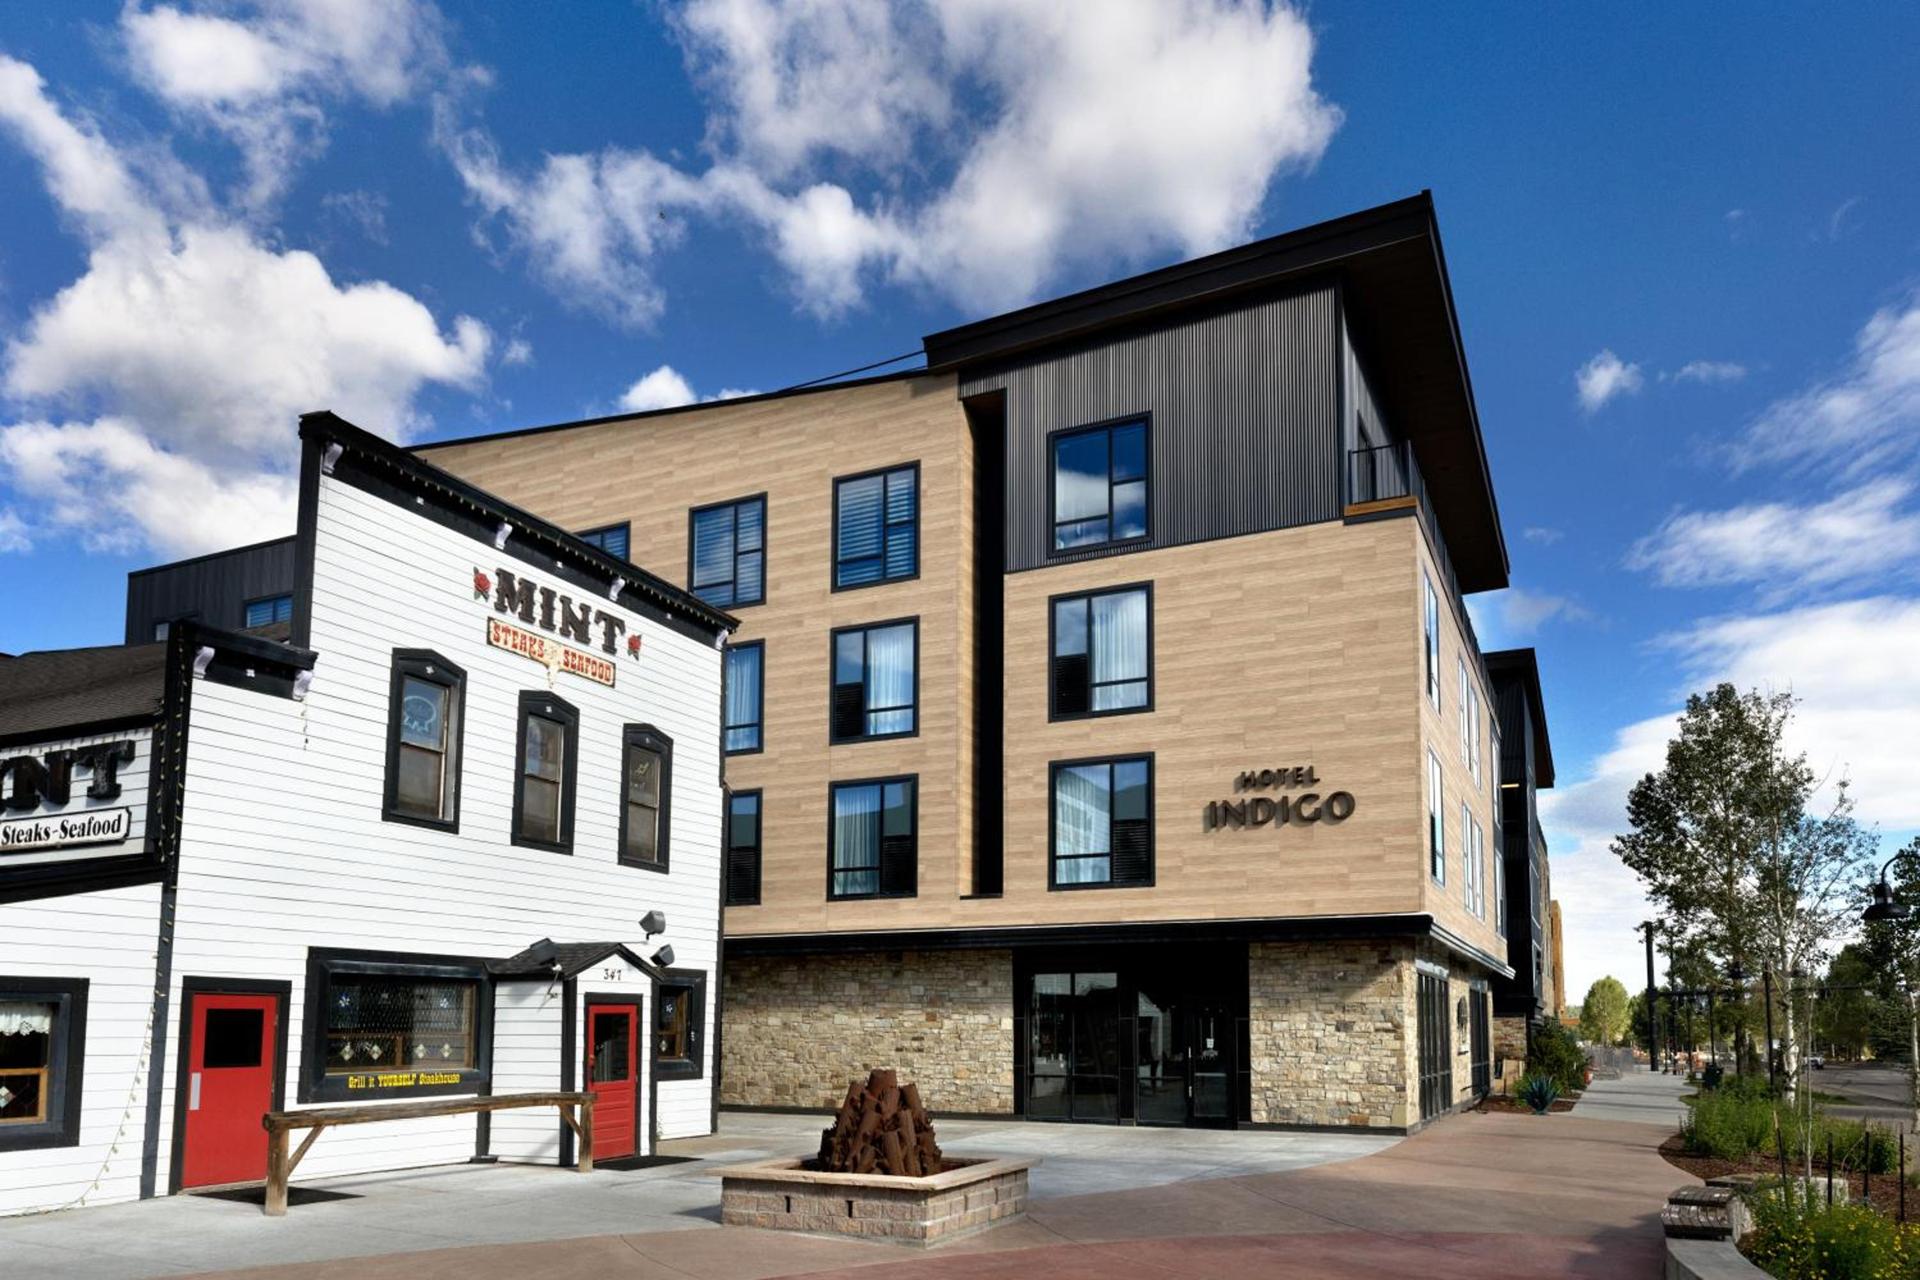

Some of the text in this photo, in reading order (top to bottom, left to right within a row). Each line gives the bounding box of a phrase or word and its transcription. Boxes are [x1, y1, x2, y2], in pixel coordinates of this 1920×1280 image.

[494, 567, 626, 655] MINT
[493, 621, 612, 683] STEAKS SEAFOOD
[1239, 765, 1320, 789] HOTEL
[1207, 790, 1356, 829] INDIGO
[348, 1075, 366, 1089] Grill
[377, 1073, 417, 1087] YOURSELF
